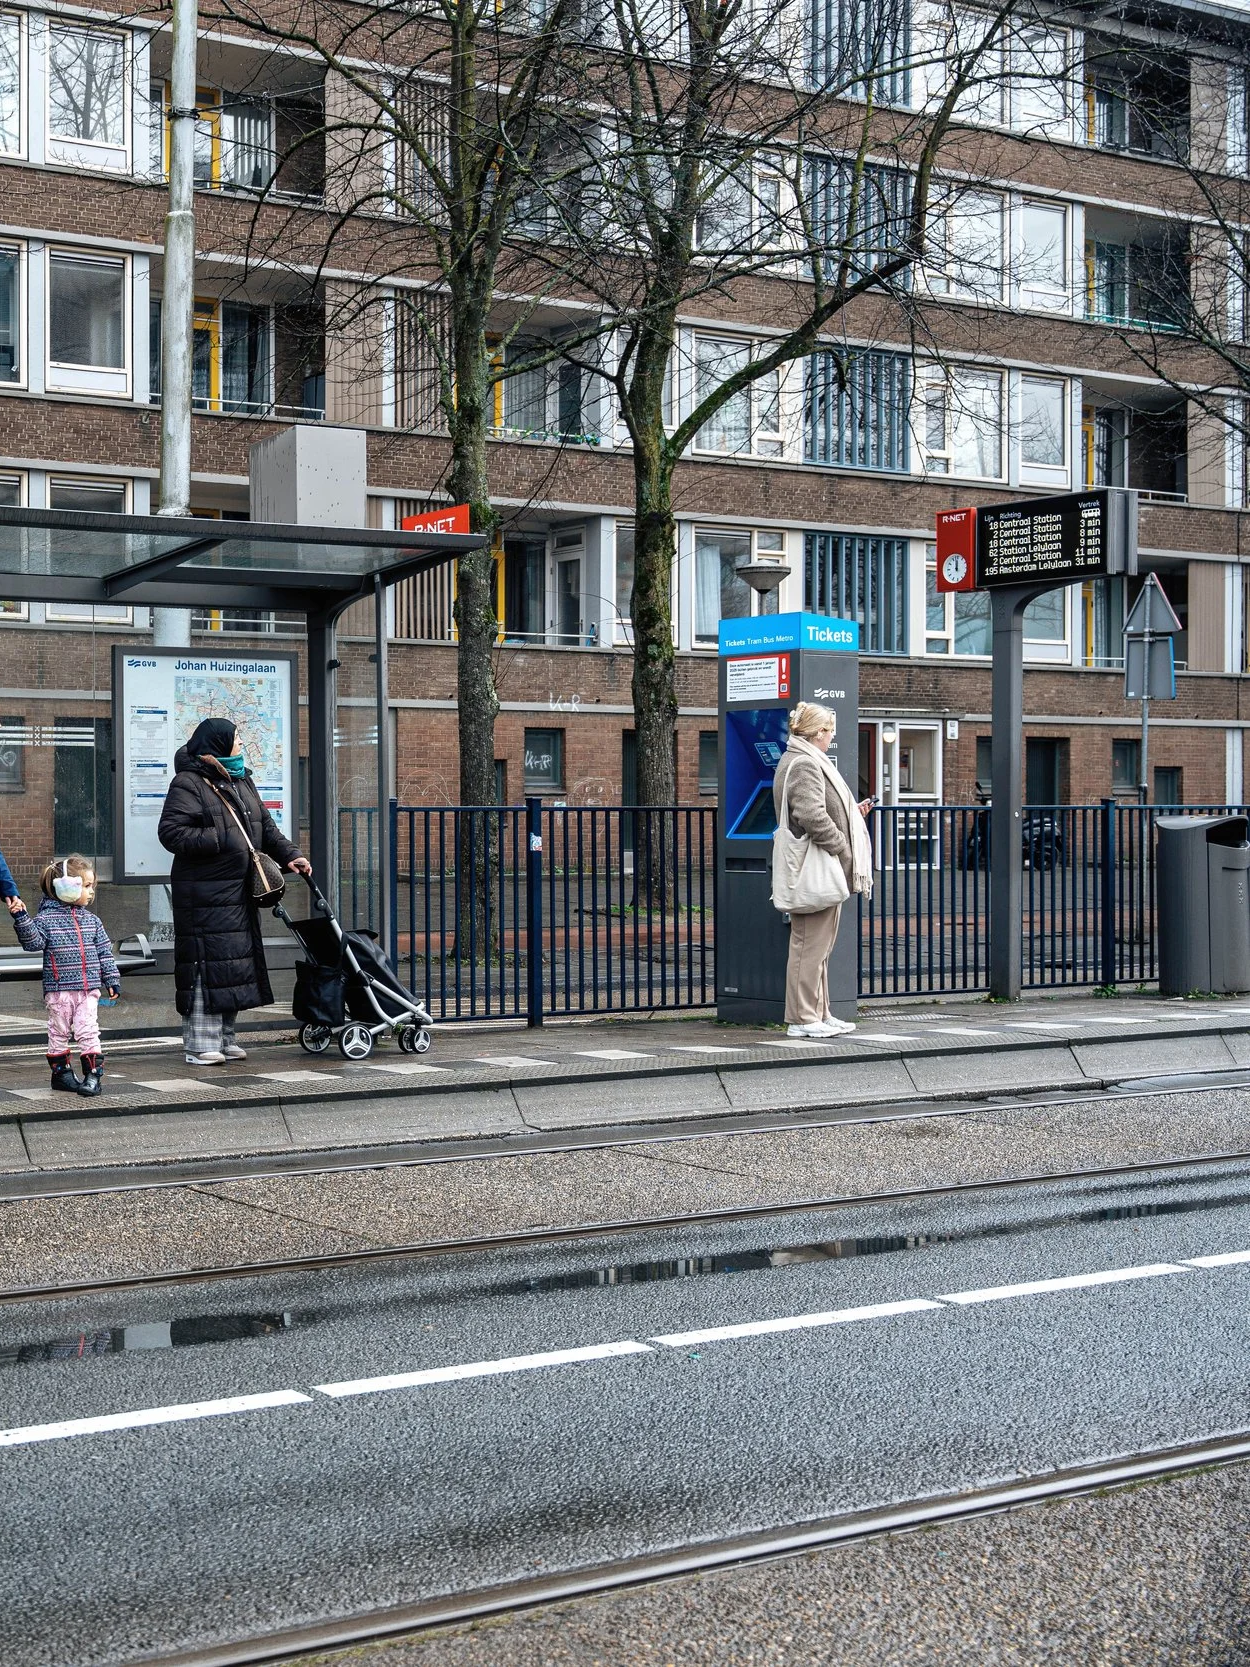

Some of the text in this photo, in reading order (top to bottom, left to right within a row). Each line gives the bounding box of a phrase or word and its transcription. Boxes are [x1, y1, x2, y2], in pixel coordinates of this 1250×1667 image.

[1078, 500, 1100, 508] Vertrek
[989, 514, 1062, 530] 18 Centraal Station
[1000, 526, 1031, 537] Centraal
[1033, 523, 1062, 533] Station
[989, 540, 998, 548] 18
[1000, 536, 1031, 546] Centraal
[1033, 533, 1062, 542] Station
[989, 549, 998, 557] 62
[1000, 546, 1026, 556] Station
[1029, 542, 1062, 552] Lelylaan
[1087, 537, 1100, 545] min
[1000, 554, 1031, 565] Centraal
[1033, 551, 1062, 561] Station
[1075, 548, 1085, 557] 11
[1087, 547, 1100, 555] min
[985, 556, 1100, 576] 195 Amsterdam Lelylaan 31 min
[807, 626, 853, 643] Tickets
[175, 660, 276, 674] Johan Huizingalaan
